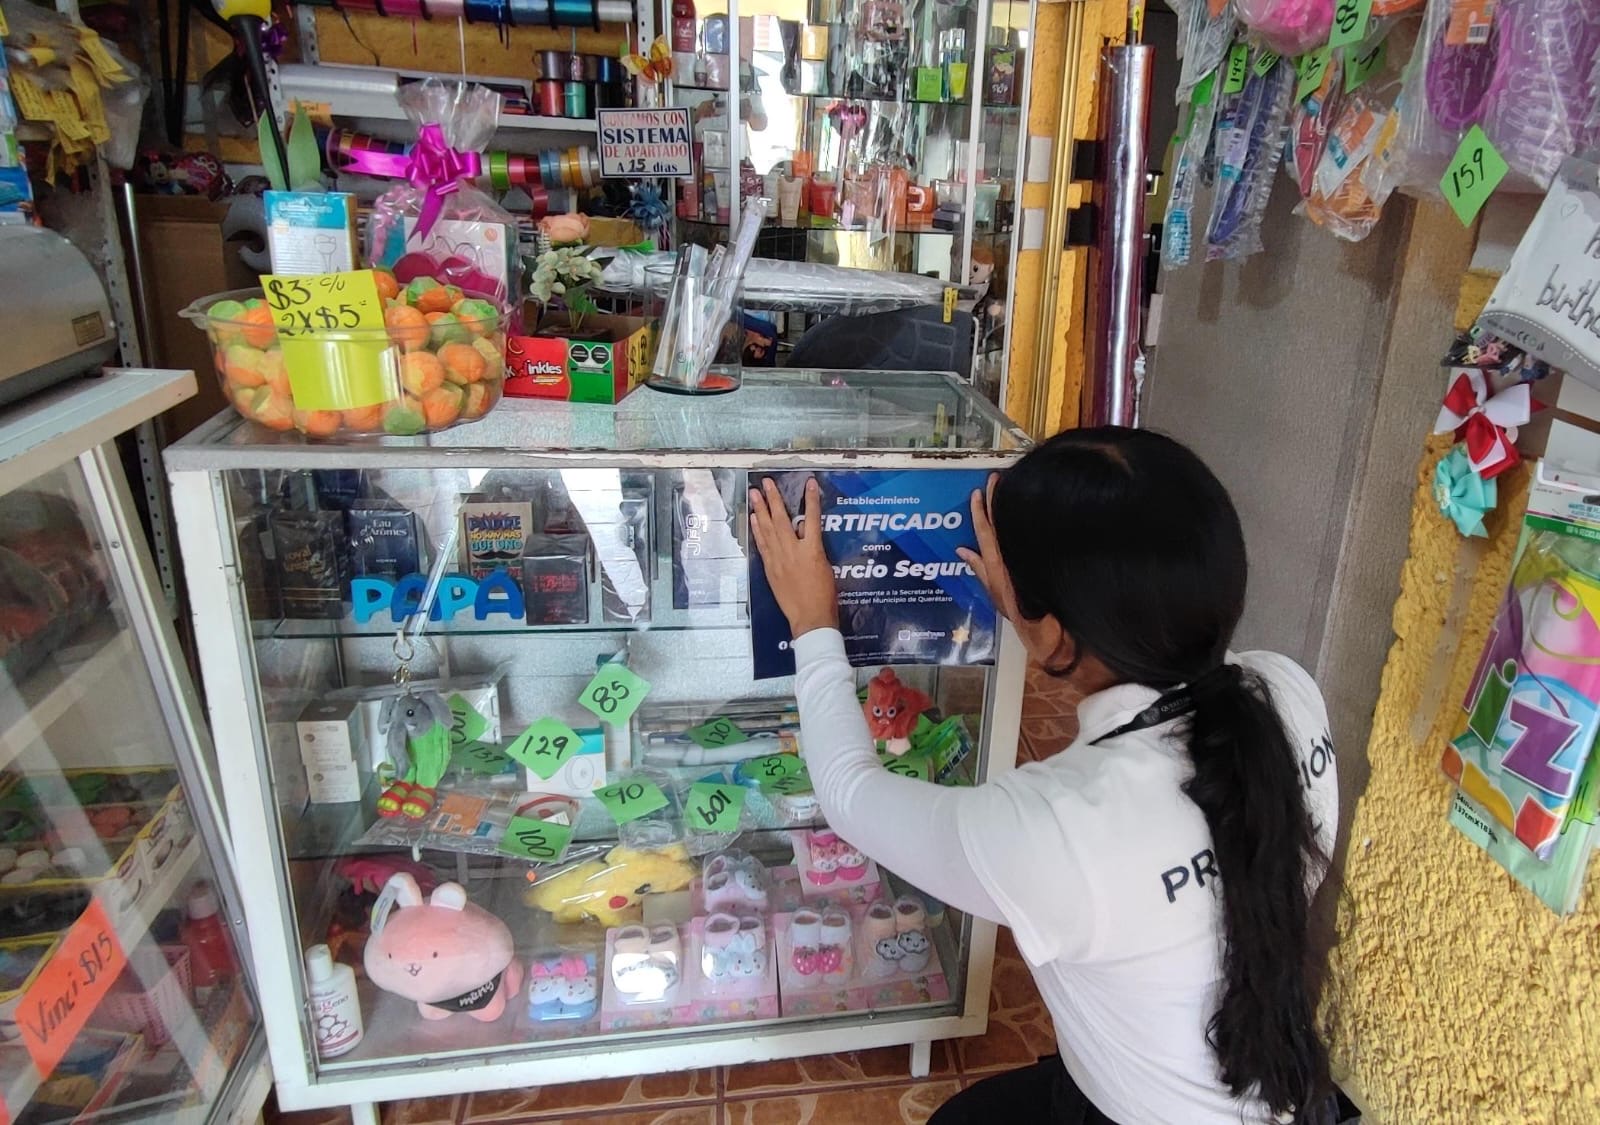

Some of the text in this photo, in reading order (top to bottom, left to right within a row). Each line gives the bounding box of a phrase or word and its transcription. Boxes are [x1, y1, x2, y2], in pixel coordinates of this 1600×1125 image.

[663, 111, 685, 125] CON
[603, 127, 688, 144] SISTEMA
[604, 144, 687, 159] DE APARTADO
[617, 162, 625, 173] A
[628, 158, 647, 172] 15
[1453, 148, 1484, 197] 159
[836, 496, 921, 505] Establecimiento
[373, 519, 391, 528] Eau
[862, 542, 891, 551] como
[832, 559, 888, 579] ercio
[351, 567, 526, 624] PAPA
[592, 680, 630, 714] 85
[521, 736, 569, 760] 129
[615, 782, 644, 804] 90
[516, 828, 556, 858] 100
